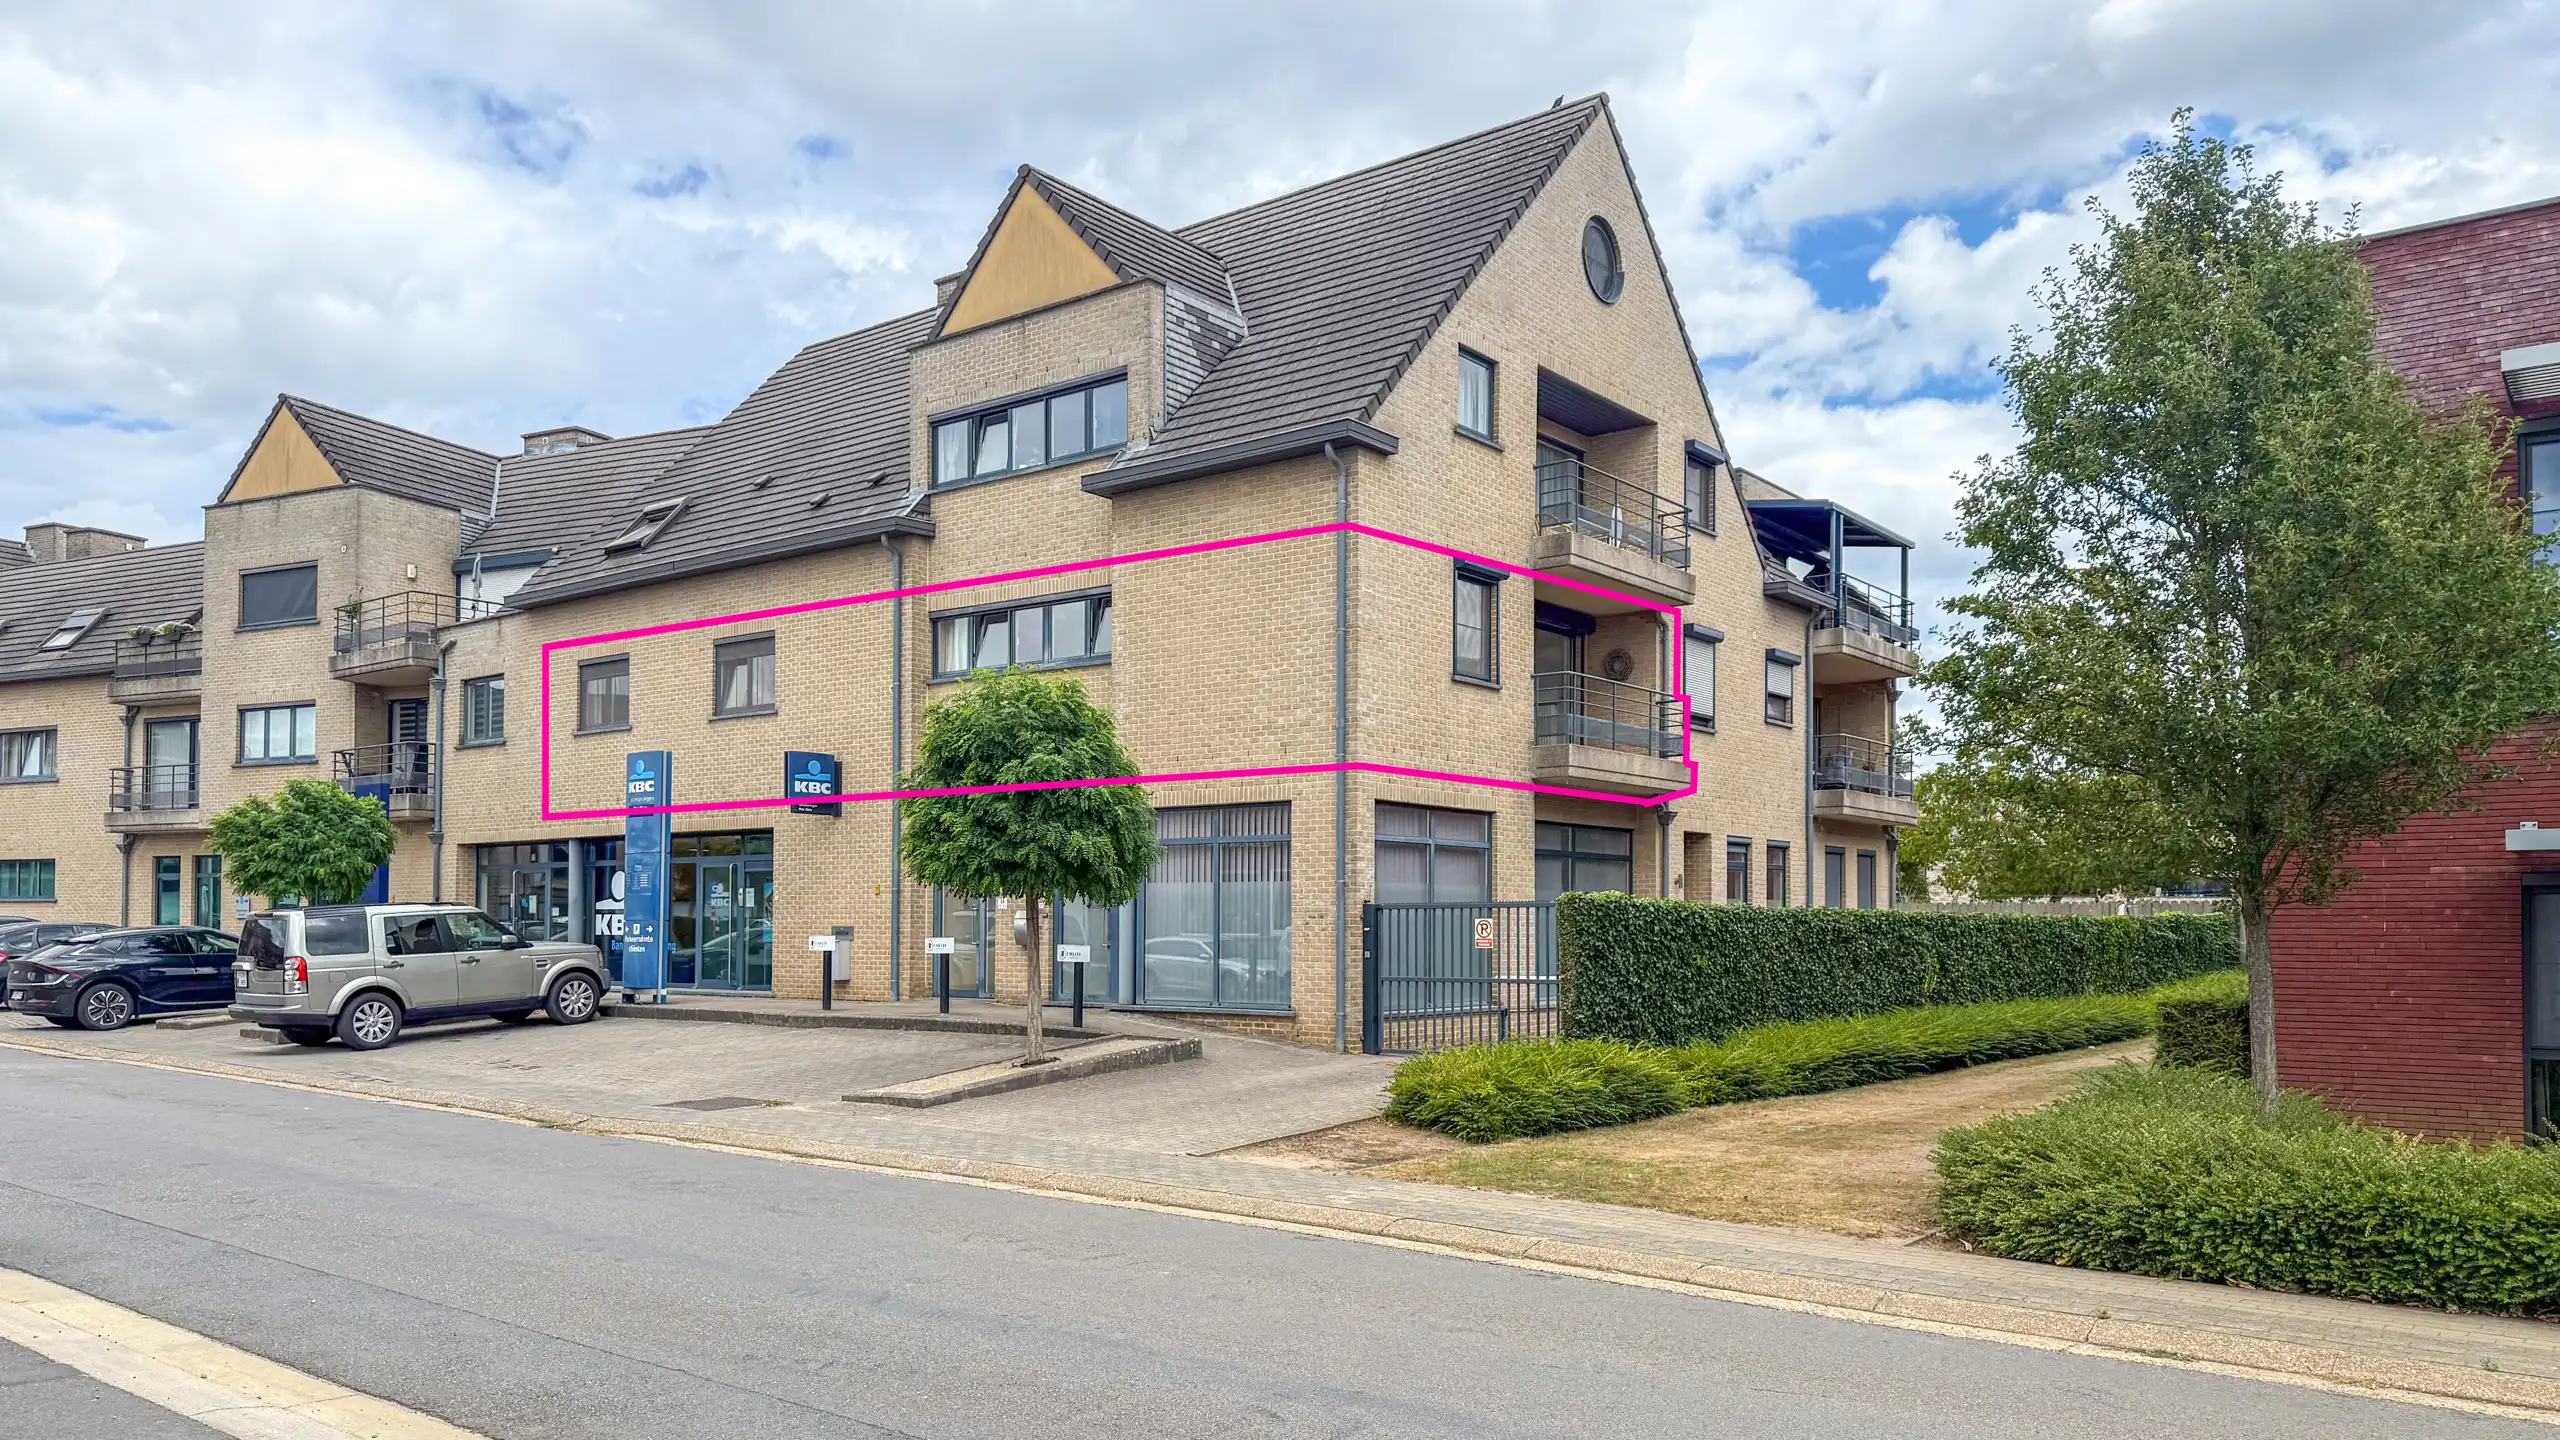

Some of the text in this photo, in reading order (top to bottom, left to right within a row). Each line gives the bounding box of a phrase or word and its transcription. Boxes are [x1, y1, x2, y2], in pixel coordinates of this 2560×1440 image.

[629, 781, 655, 793] KBC
[795, 781, 831, 794] KBC
[711, 898, 730, 907] KBC
[595, 914, 624, 935] KB
[611, 940, 624, 950] Ban
